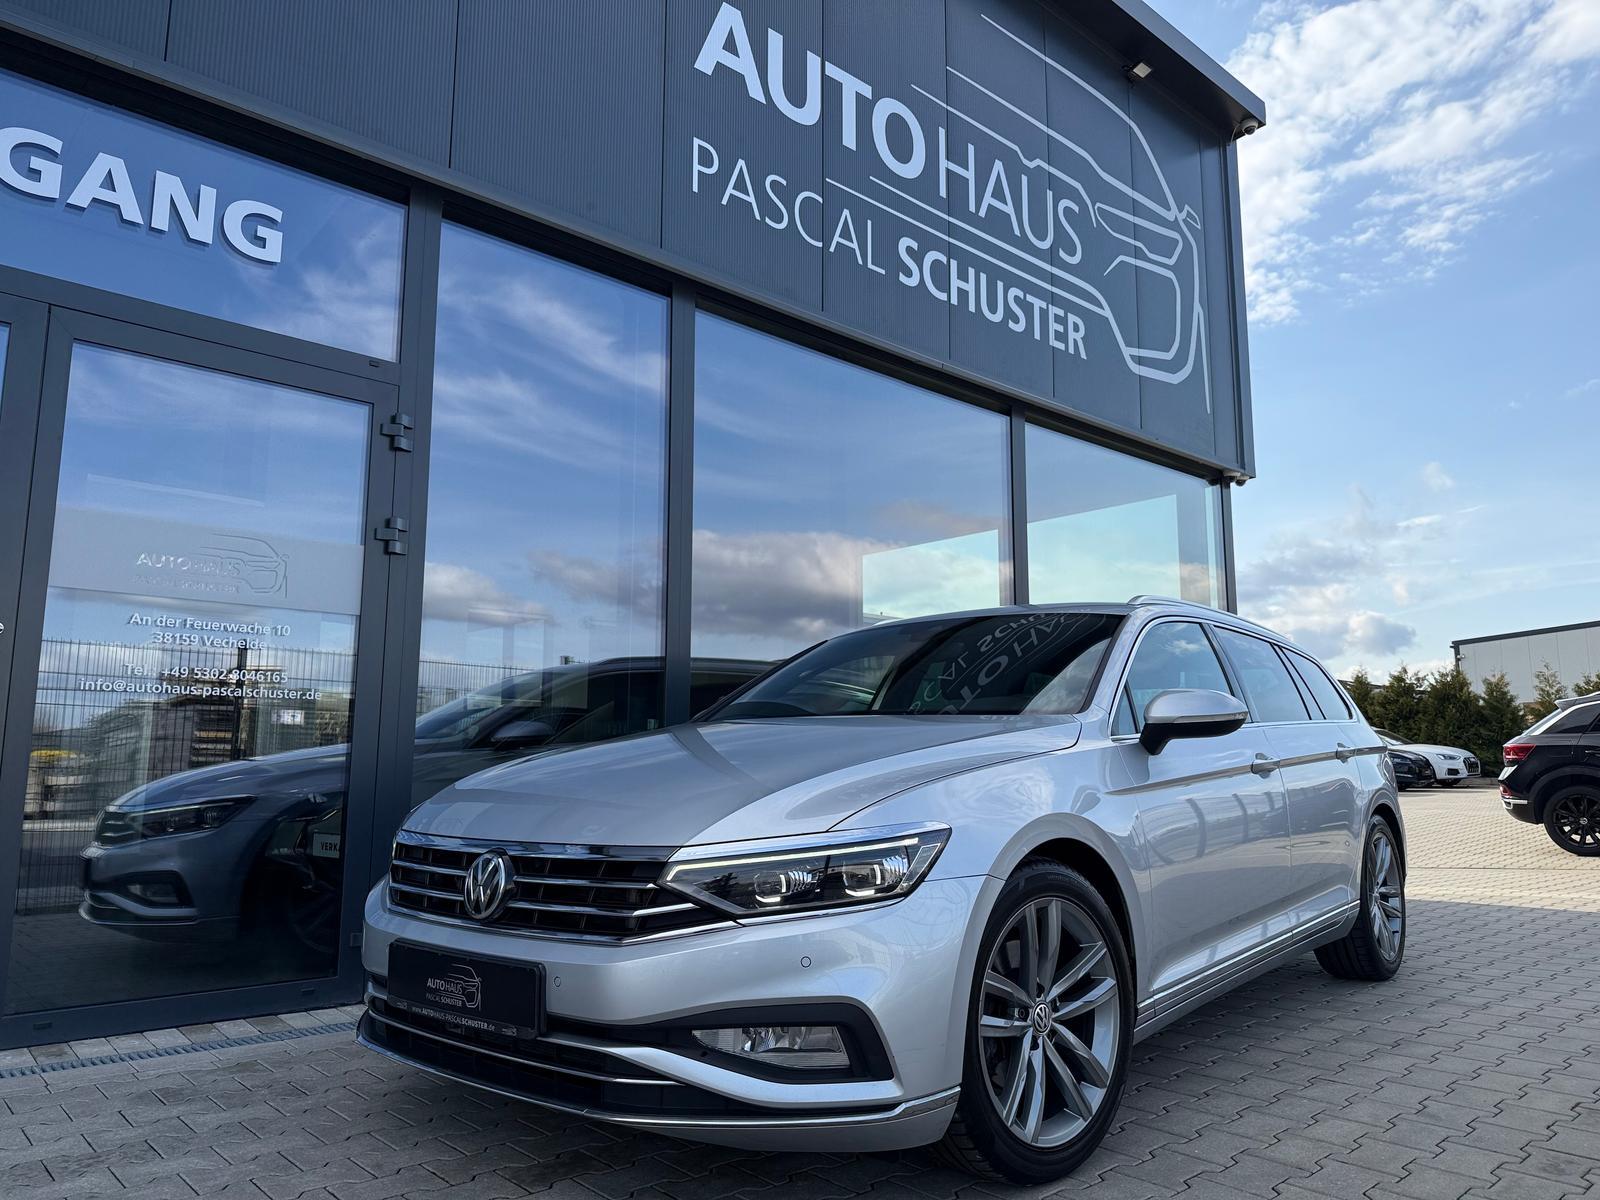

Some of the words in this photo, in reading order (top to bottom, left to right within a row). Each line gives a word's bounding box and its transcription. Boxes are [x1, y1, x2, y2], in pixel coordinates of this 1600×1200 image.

[694, 2, 1083, 265] AUTOHAUS
[0, 127, 283, 262] GANG
[692, 137, 885, 275] PASCAL
[898, 237, 1087, 360] SCHUSTER
[130, 613, 151, 625] An
[157, 615, 181, 627] der
[186, 617, 271, 635] Feuerwache
[277, 625, 291, 636] 10
[154, 632, 199, 645] 38159
[204, 635, 266, 650] Vechelde
[161, 666, 188, 678] +49
[79, 678, 321, 700] info@autohaus-pascalschuster.de
[426, 977, 463, 995] AUTOHAUS
[426, 993, 441, 1002] PASCAL
[441, 997, 462, 1007] SCHUSTER
